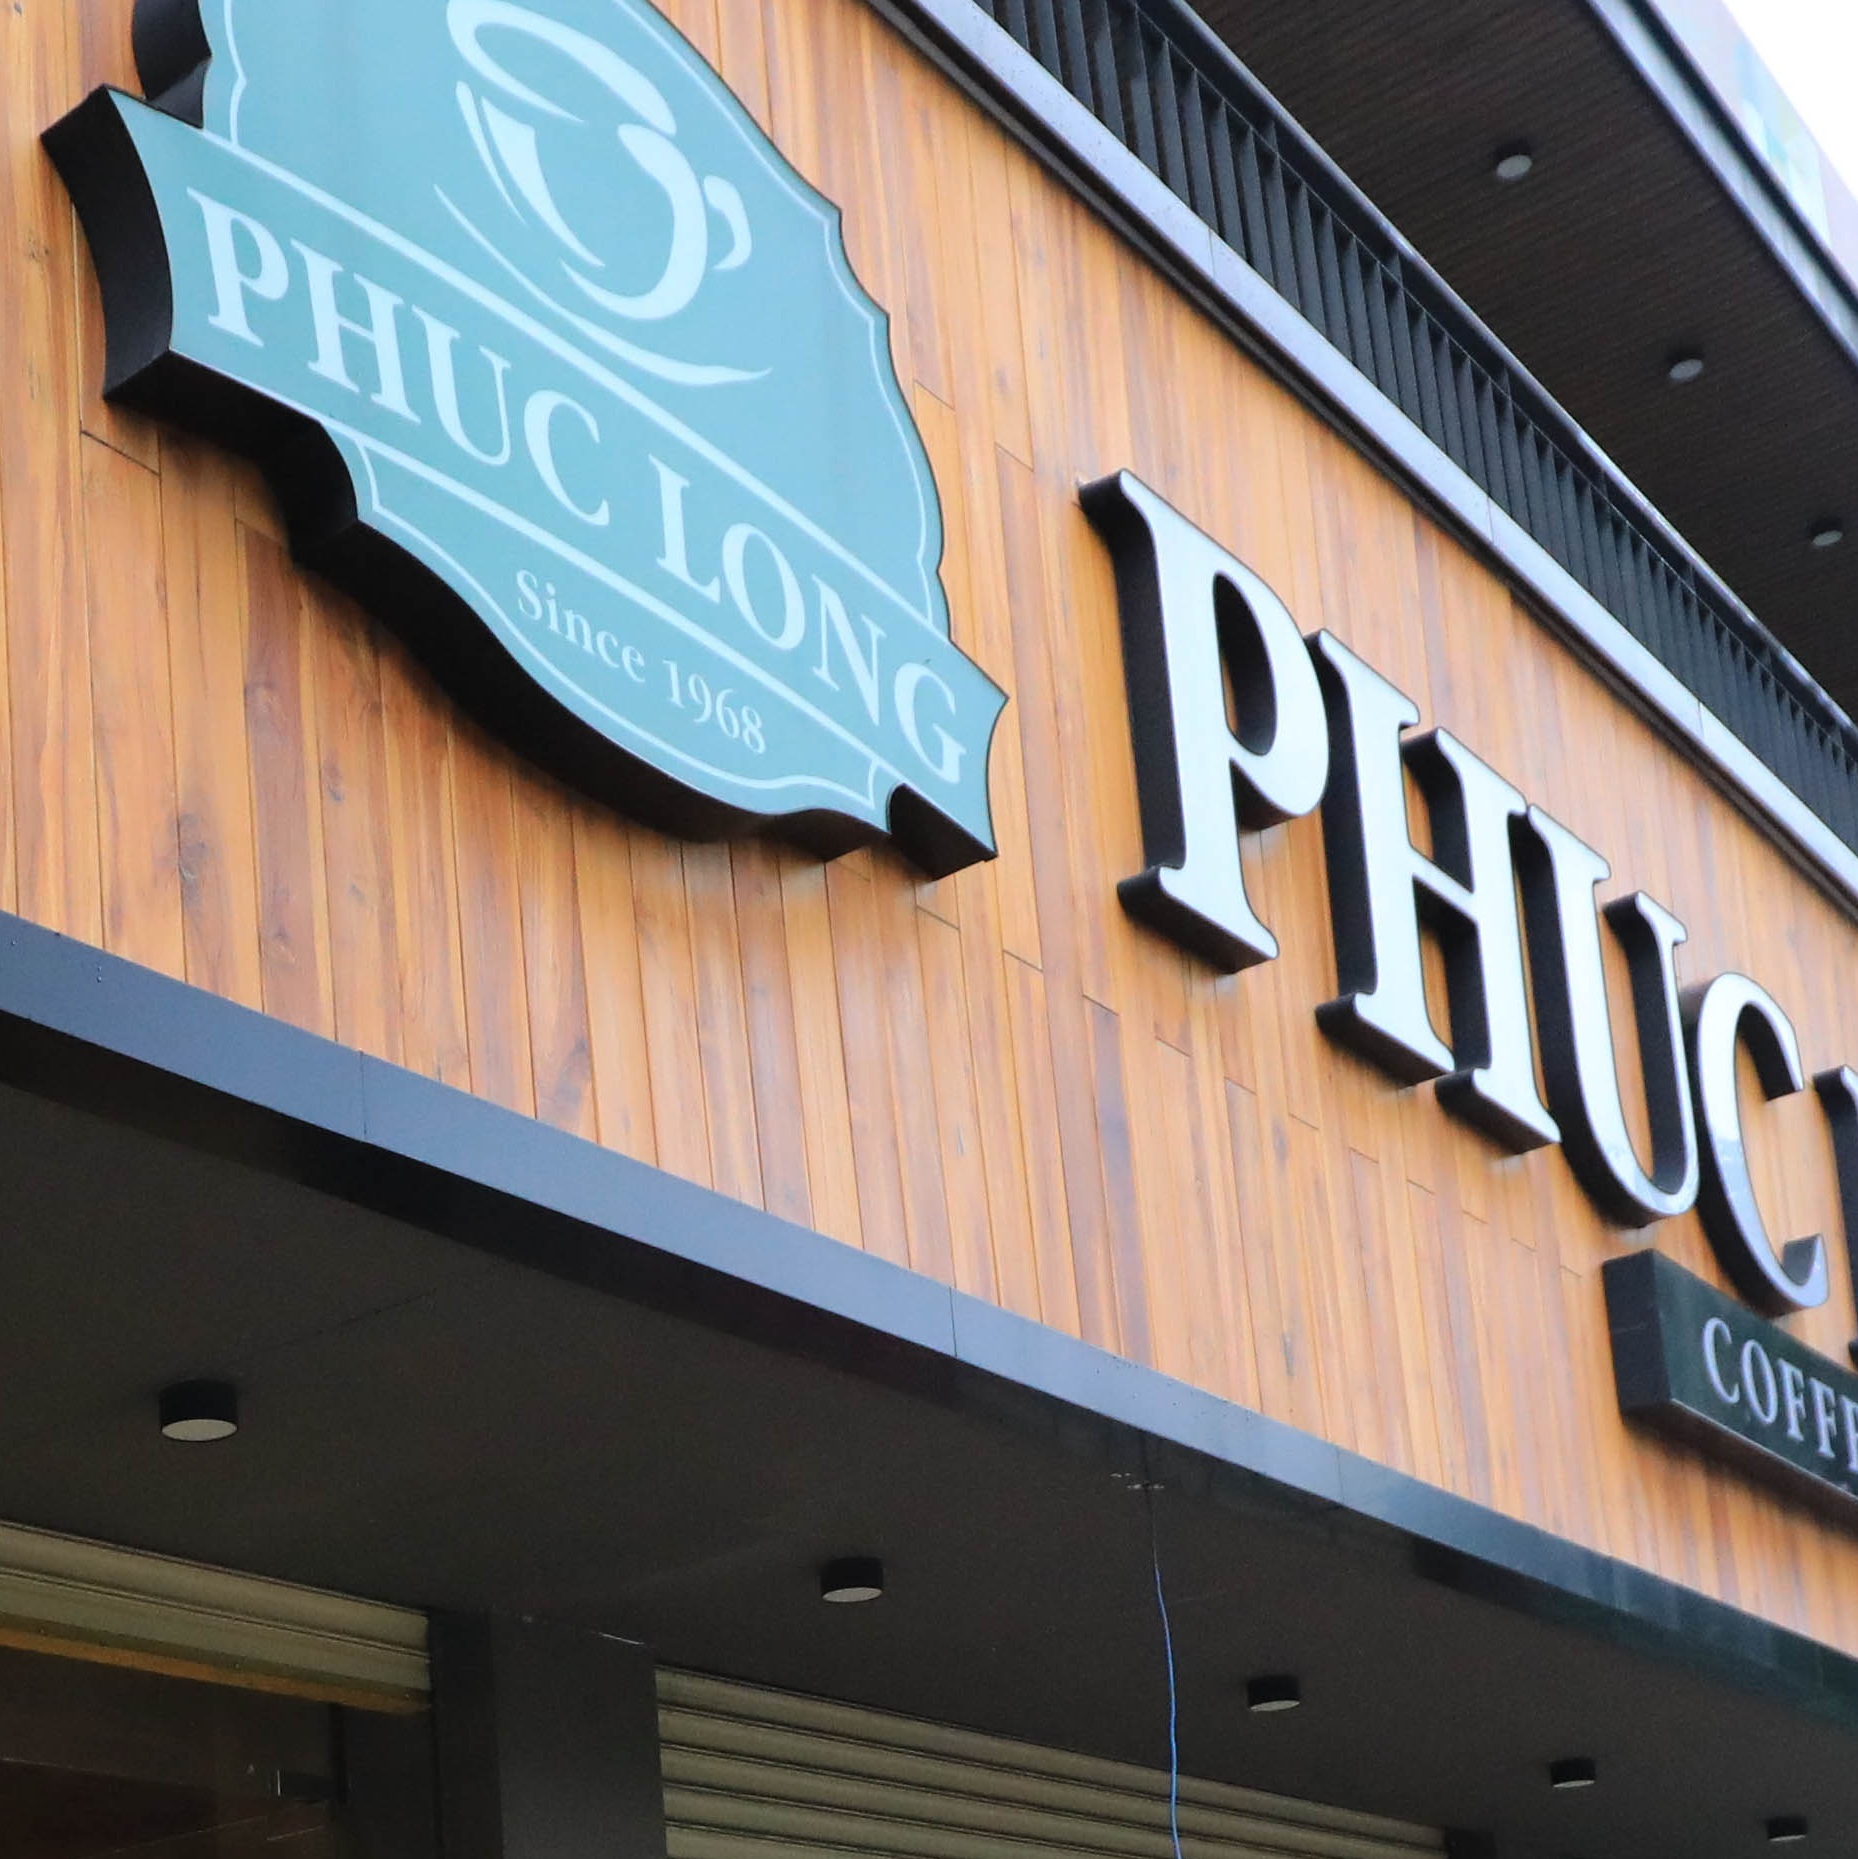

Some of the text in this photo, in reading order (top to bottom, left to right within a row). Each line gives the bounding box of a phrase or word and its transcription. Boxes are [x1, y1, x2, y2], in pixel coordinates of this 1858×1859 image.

[187, 187, 966, 785] PHUC LONG
[516, 569, 769, 755] Since 1968
[1086, 468, 1829, 1312] PHUC
